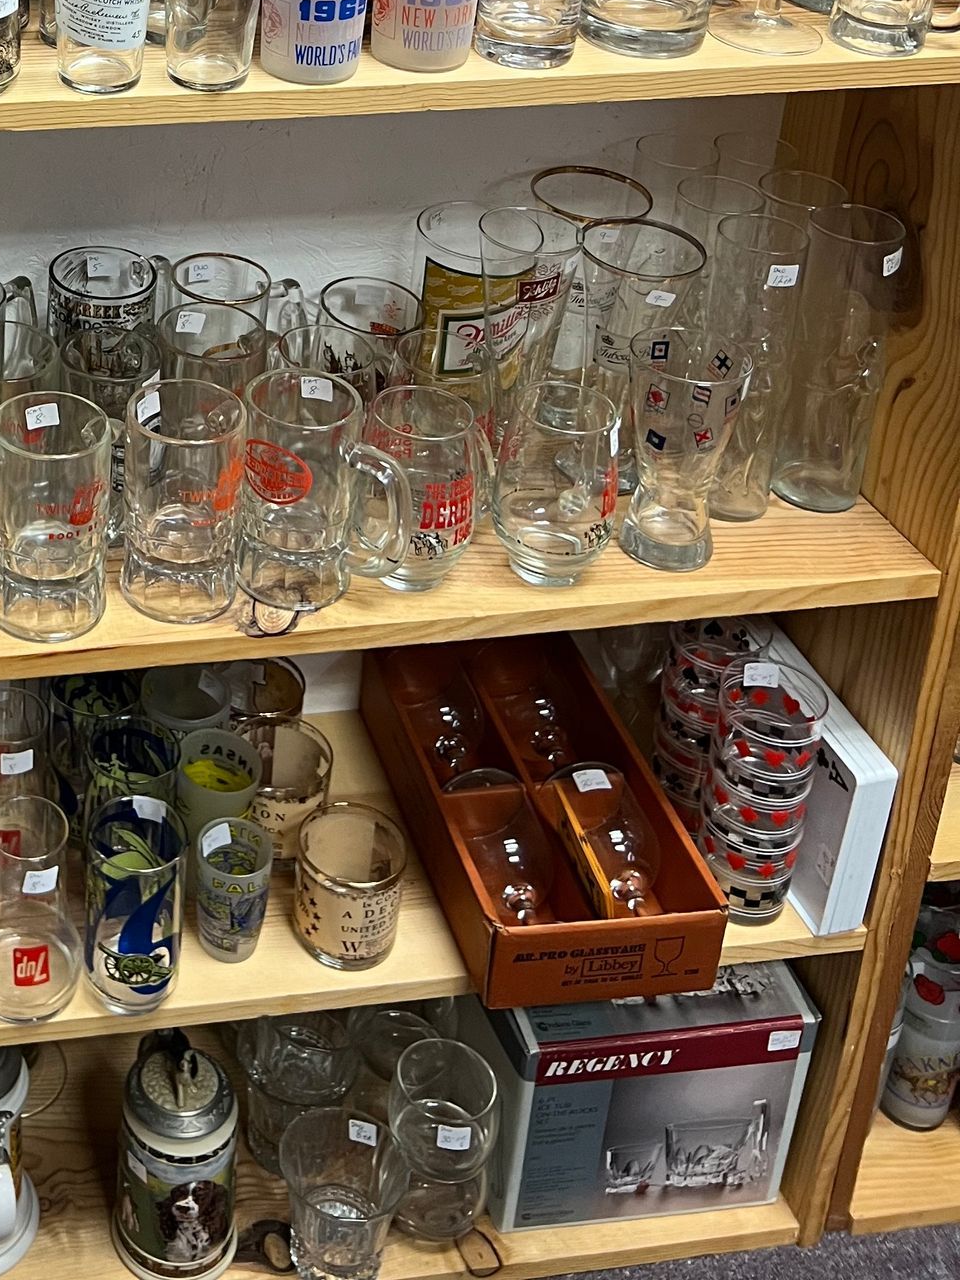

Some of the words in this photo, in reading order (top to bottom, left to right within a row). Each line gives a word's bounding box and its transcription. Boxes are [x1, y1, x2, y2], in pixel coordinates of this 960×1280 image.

[402, 6, 436, 30] NEW
[402, 27, 455, 52] WORLD'S
[295, 40, 345, 67] WORLD'S
[211, 876, 271, 895] FAL
[341, 920, 386, 934] UNITED
[569, 943, 647, 959] GLASSWARE
[564, 963, 579, 976] by
[588, 957, 638, 973] Libbey
[543, 1048, 681, 1078] REGENCY
